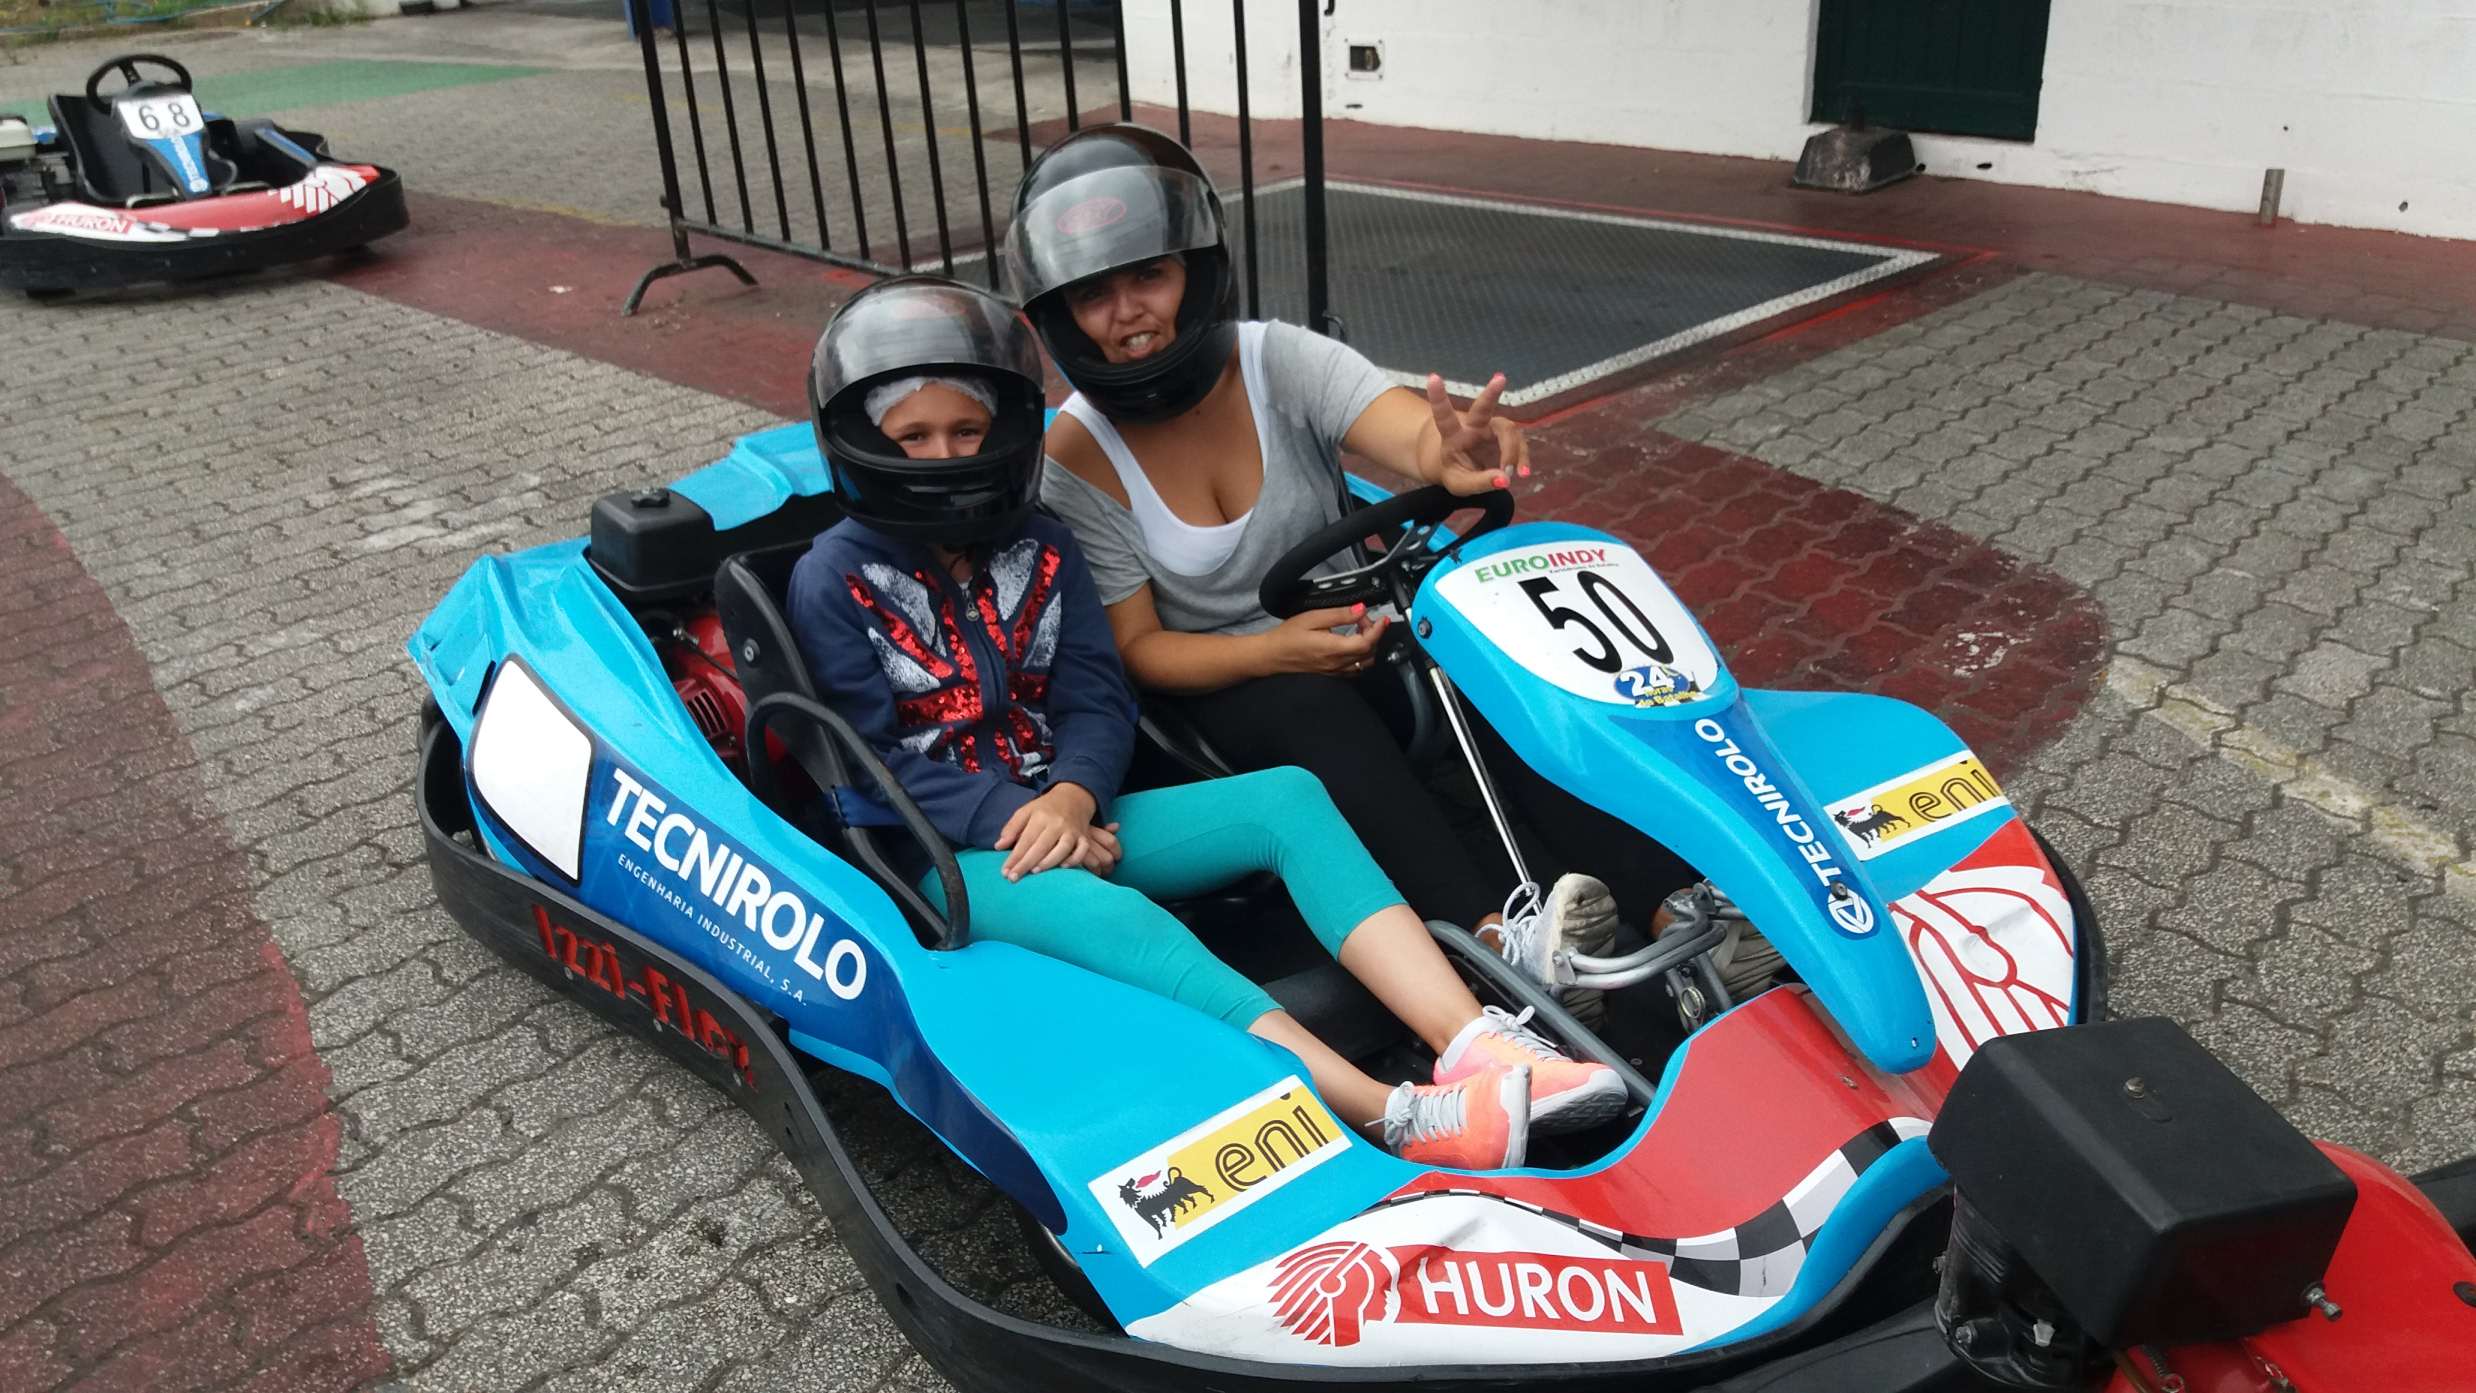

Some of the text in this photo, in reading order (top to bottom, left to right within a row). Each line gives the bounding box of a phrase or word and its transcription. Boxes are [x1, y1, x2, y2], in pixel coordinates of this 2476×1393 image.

[1475, 548, 1608, 584] EUROINDY
[1518, 570, 1675, 674] 50
[1619, 665, 1676, 697] 24
[1694, 718, 1843, 887] TECNIROLO
[1909, 759, 2001, 822] eni
[606, 767, 867, 1000] TECNIROLO
[617, 853, 808, 1006] ENGENHARIA INDUSTRIAL, S.A.
[1215, 1091, 1331, 1193] eni
[1418, 1256, 1660, 1325] HURON
